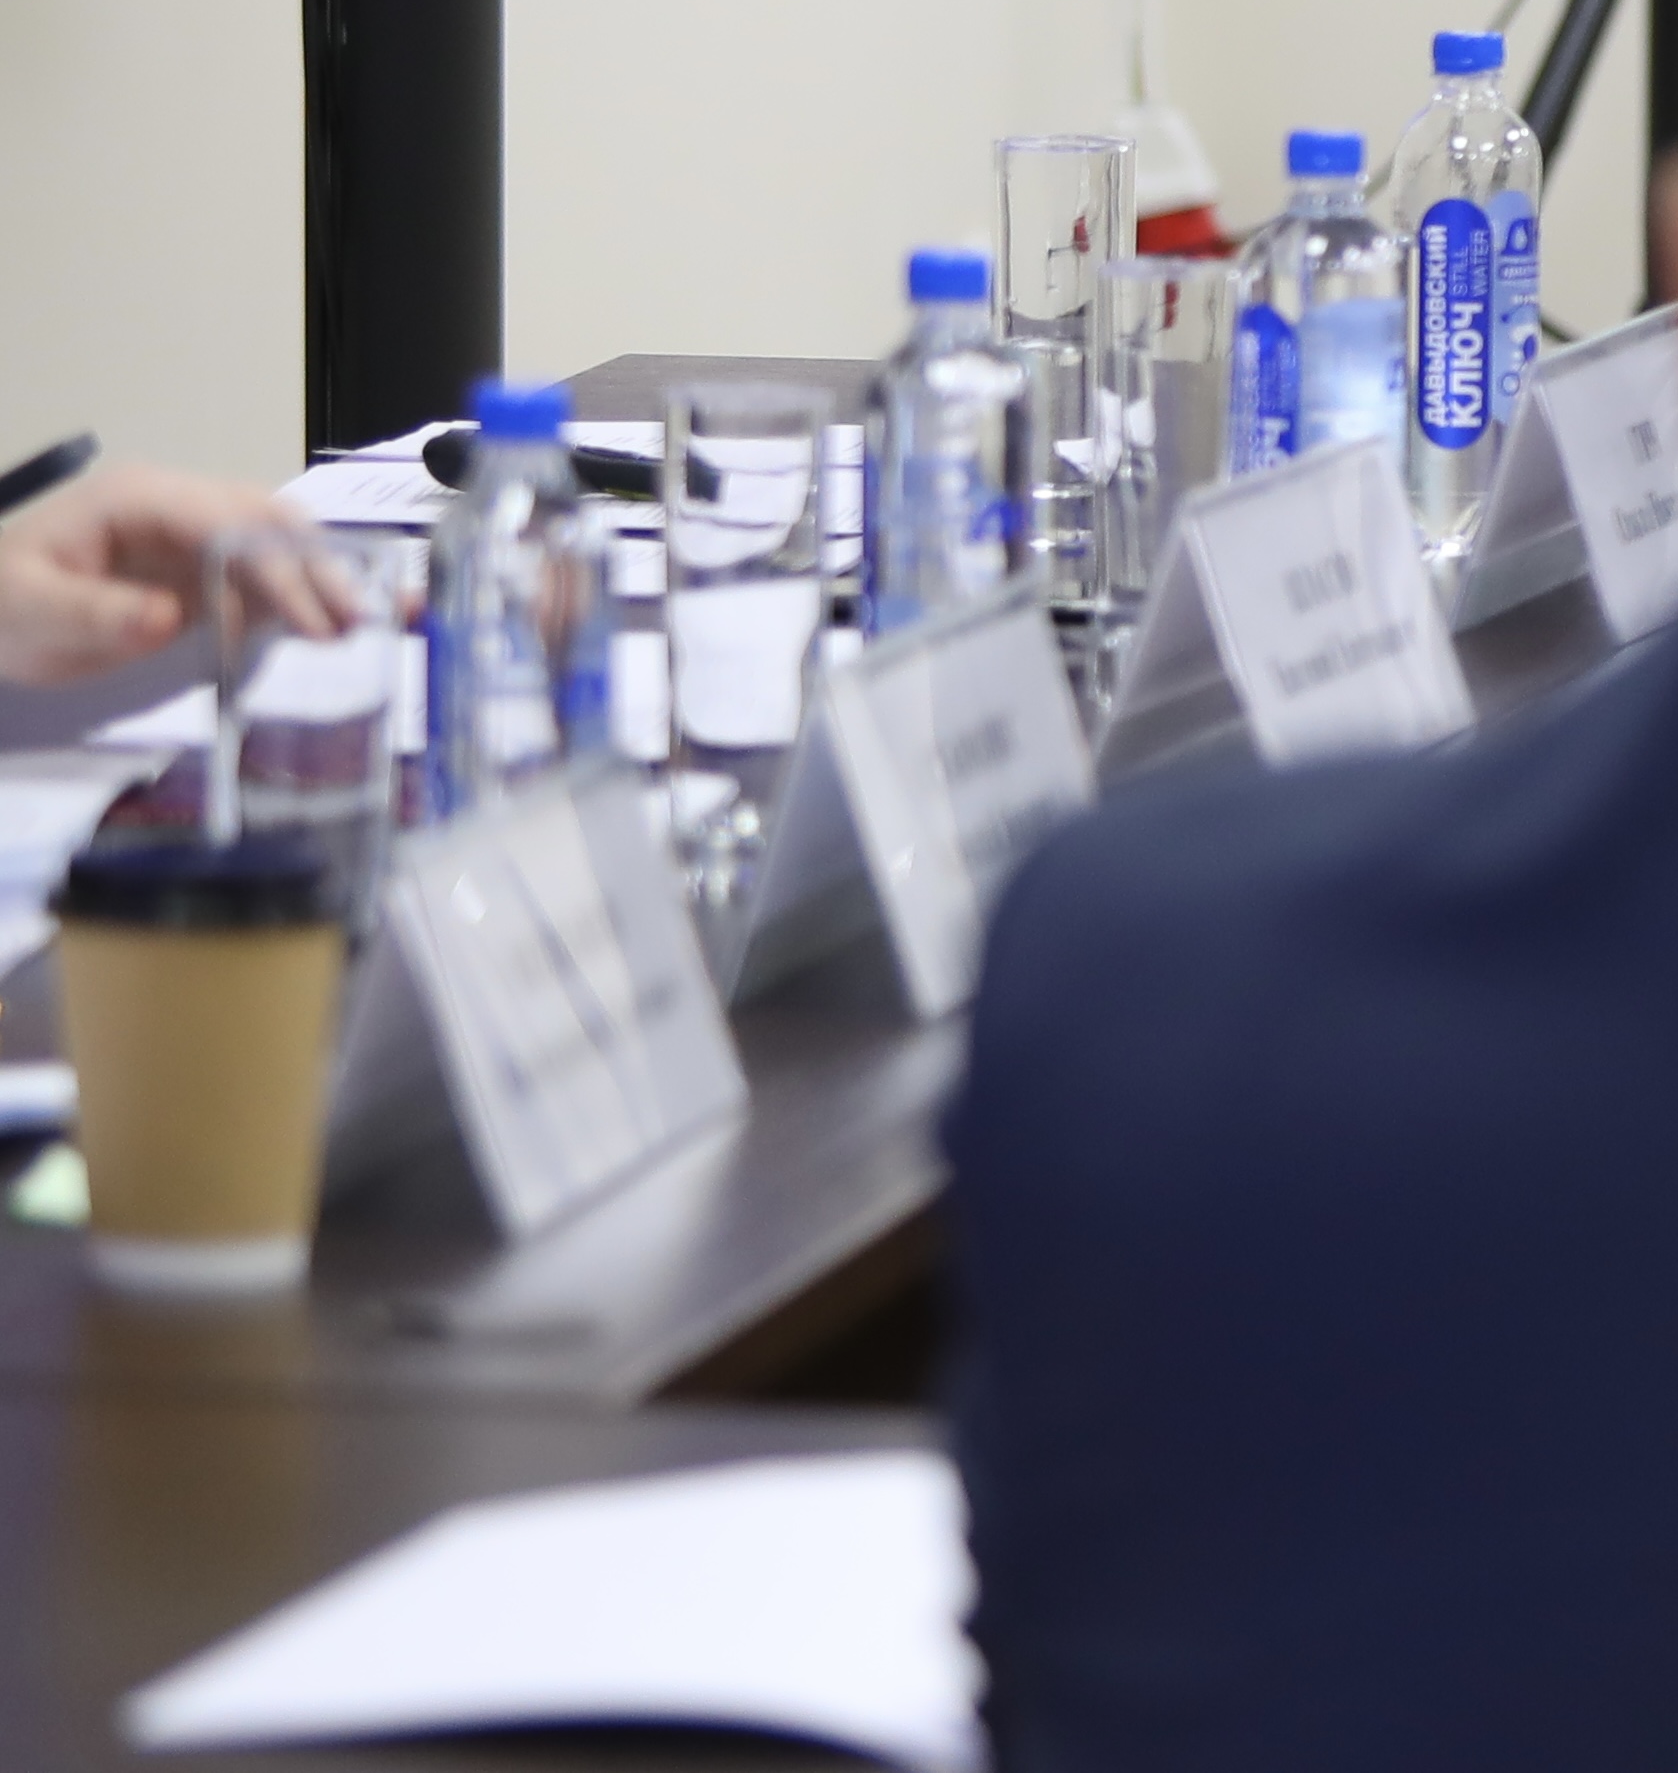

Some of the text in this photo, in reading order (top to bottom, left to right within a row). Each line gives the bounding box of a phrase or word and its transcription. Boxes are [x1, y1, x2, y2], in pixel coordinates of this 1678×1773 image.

[1452, 246, 1469, 296] STILL
[1470, 229, 1488, 297] WATER
[1423, 224, 1449, 428] ДАВЫДОВСКИЙ
[1450, 302, 1484, 428] КЛЮЧ
